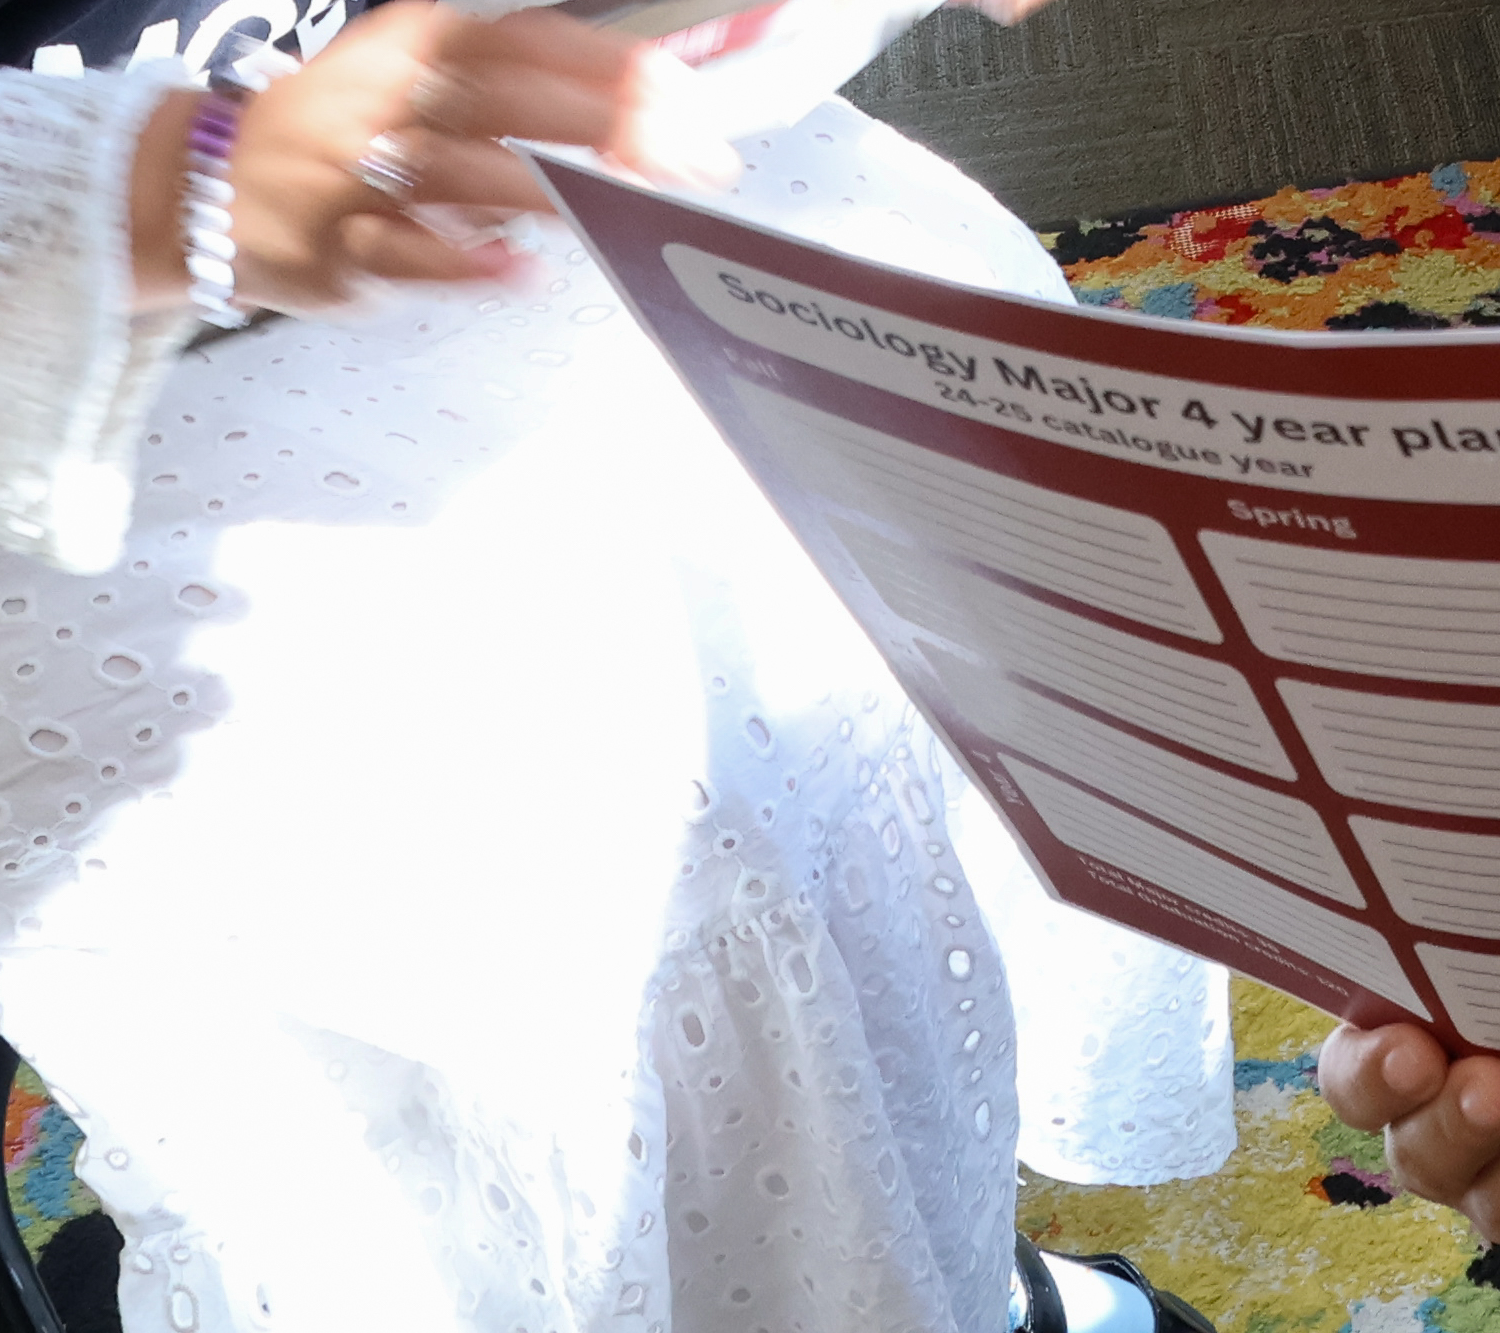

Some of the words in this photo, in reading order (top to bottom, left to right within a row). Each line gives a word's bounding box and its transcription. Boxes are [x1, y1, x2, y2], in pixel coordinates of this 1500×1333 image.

[717, 270, 977, 381] Sociology
[993, 356, 1161, 420] Major
[1181, 398, 1217, 430] 4
[1231, 407, 1371, 446] year
[934, 380, 1033, 424] 24-25
[1041, 412, 1222, 465] catalogue
[1229, 450, 1315, 480] year
[1226, 497, 1358, 540] Spring
[1078, 856, 1124, 881] Total
[1126, 876, 1179, 906] Major
[1087, 870, 1134, 896] Total
[1137, 892, 1240, 944] Graduation
